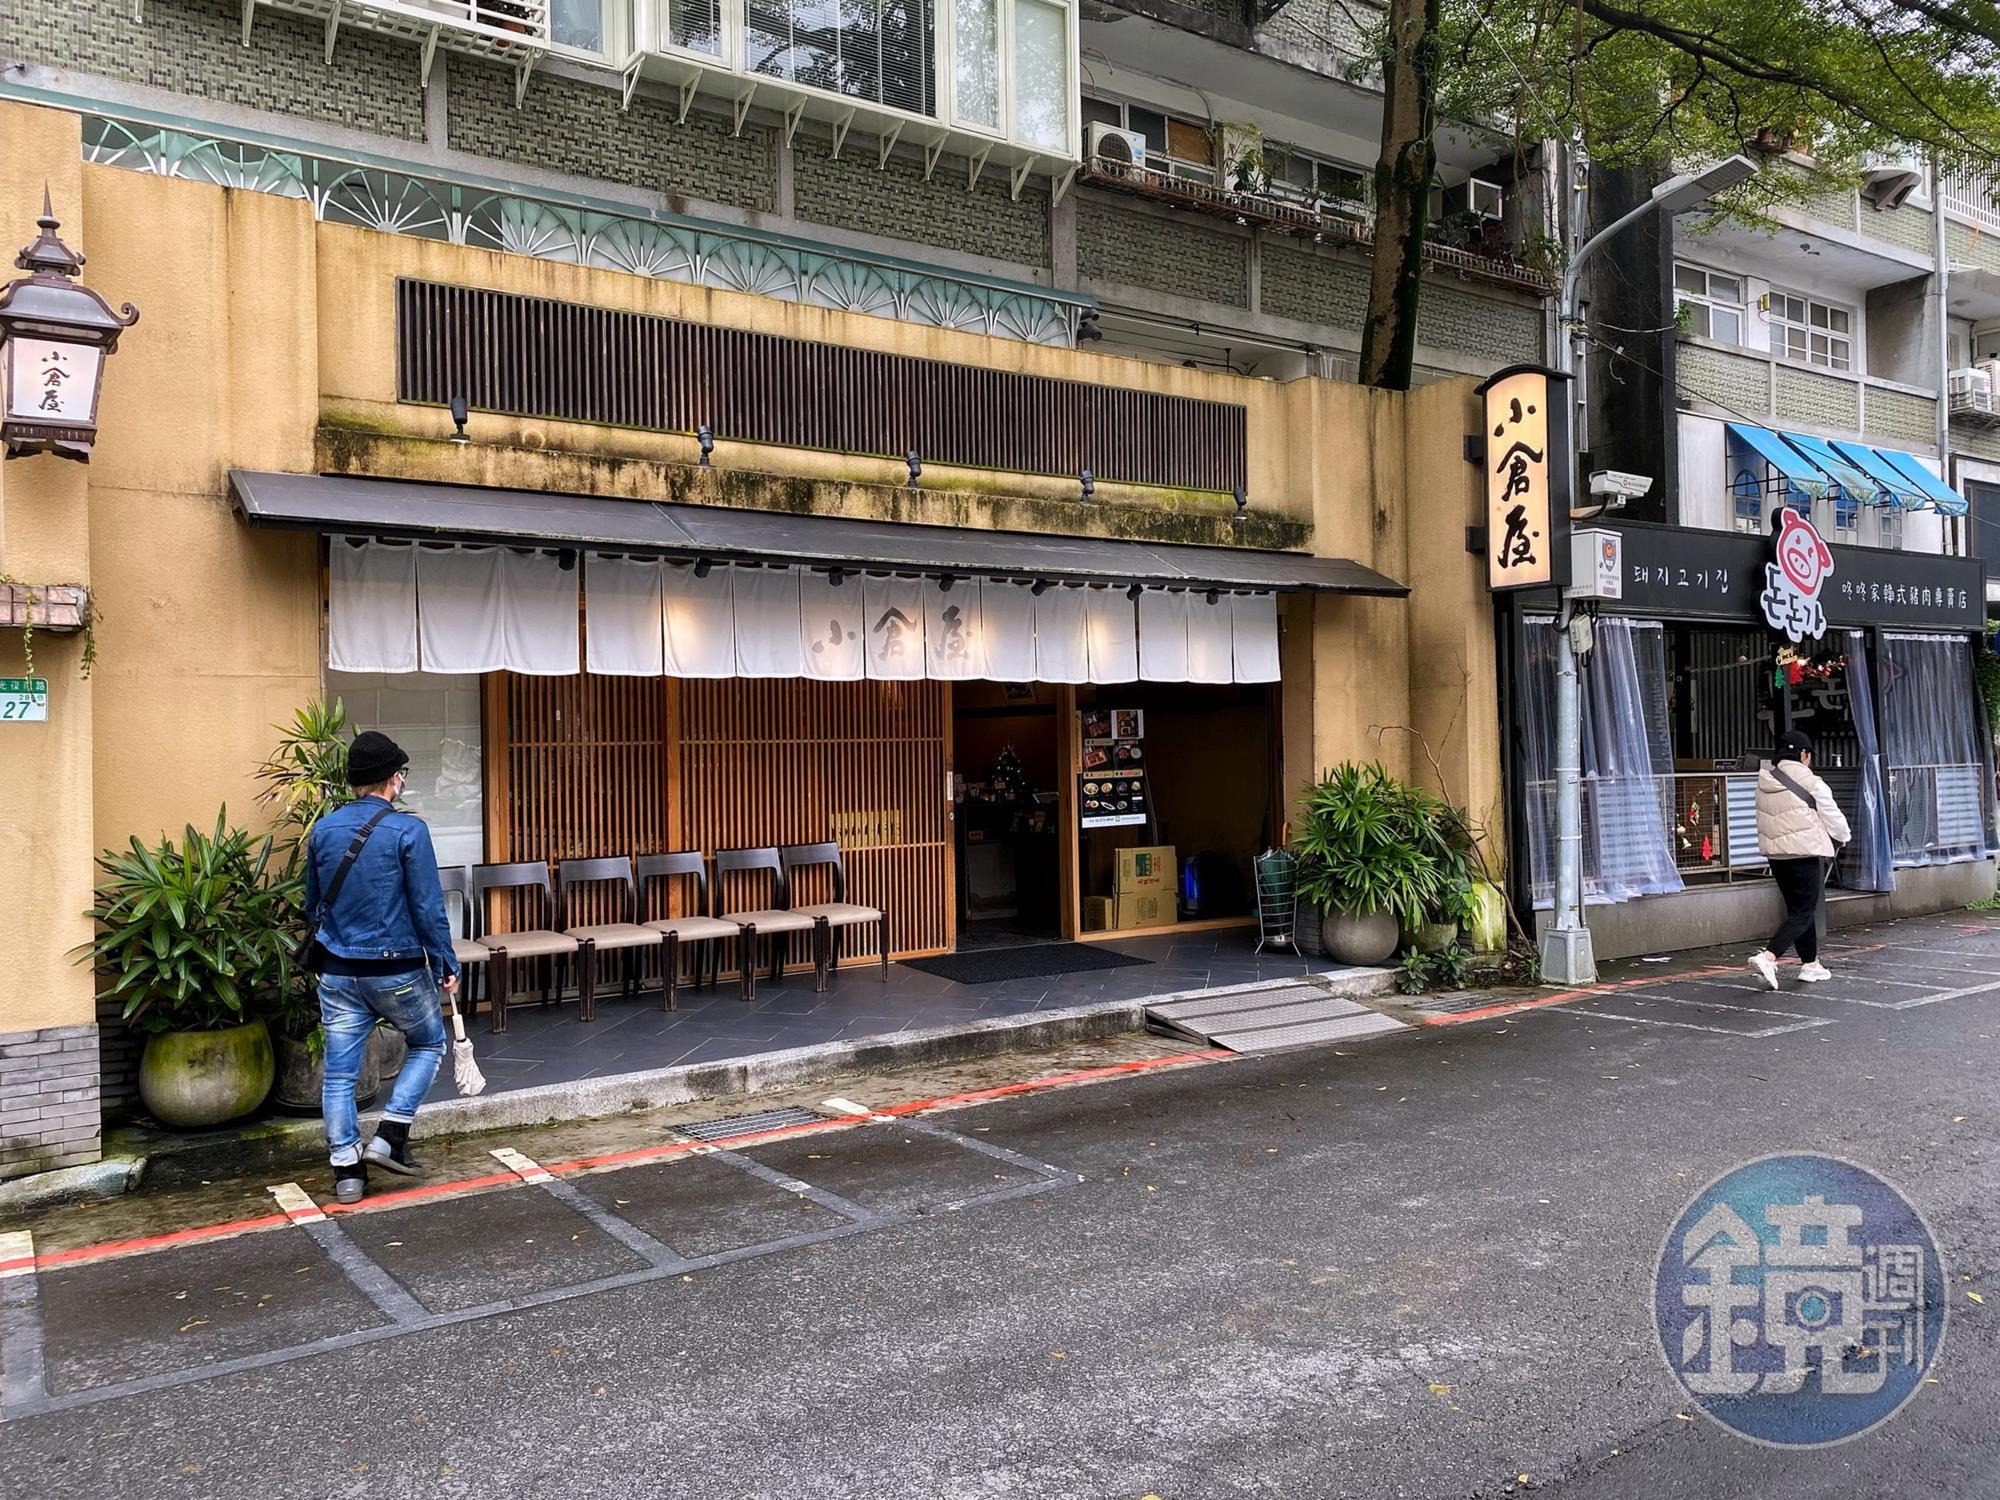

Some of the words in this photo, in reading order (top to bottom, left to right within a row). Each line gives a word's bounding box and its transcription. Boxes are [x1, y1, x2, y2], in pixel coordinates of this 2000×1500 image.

[39, 351, 70, 412] 小倉屋
[1494, 398, 1543, 568] 小倉屋
[1633, 565, 1729, 594] 돼지고기집
[1763, 565, 1824, 634] 돈돈가
[1841, 580, 1967, 609] 咚咚家韓式豬肉專賣店
[812, 605, 973, 661] 小倉屋
[0, 680, 46, 690] 光復路
[3, 701, 31, 719] 27
